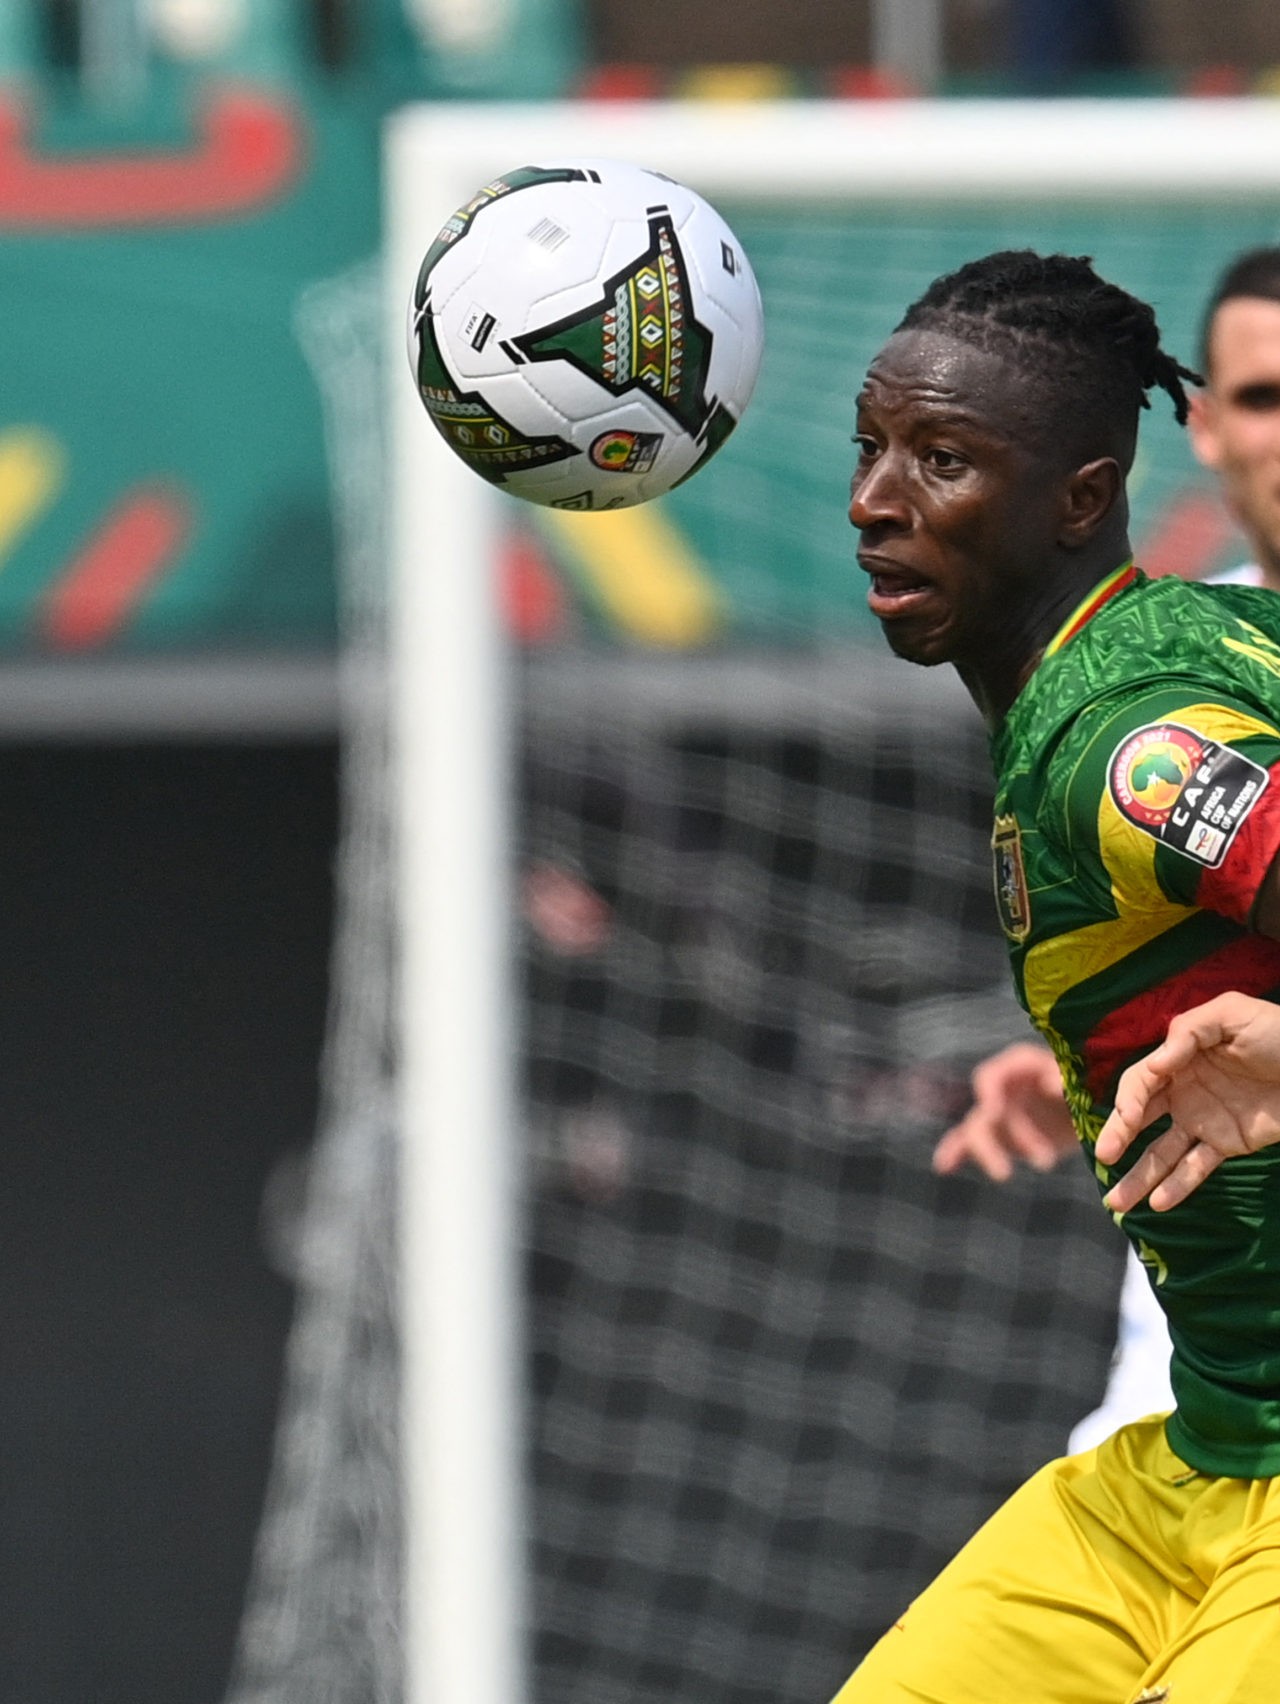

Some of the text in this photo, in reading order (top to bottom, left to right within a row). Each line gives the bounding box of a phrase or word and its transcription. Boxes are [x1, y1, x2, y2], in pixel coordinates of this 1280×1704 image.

[1114, 740, 1141, 805] CAMEROON
[1172, 764, 1212, 827] CAF
[1200, 786, 1227, 820] AFRICA
[1210, 804, 1226, 825] CUP
[1220, 780, 1257, 830] OF NATIONS
